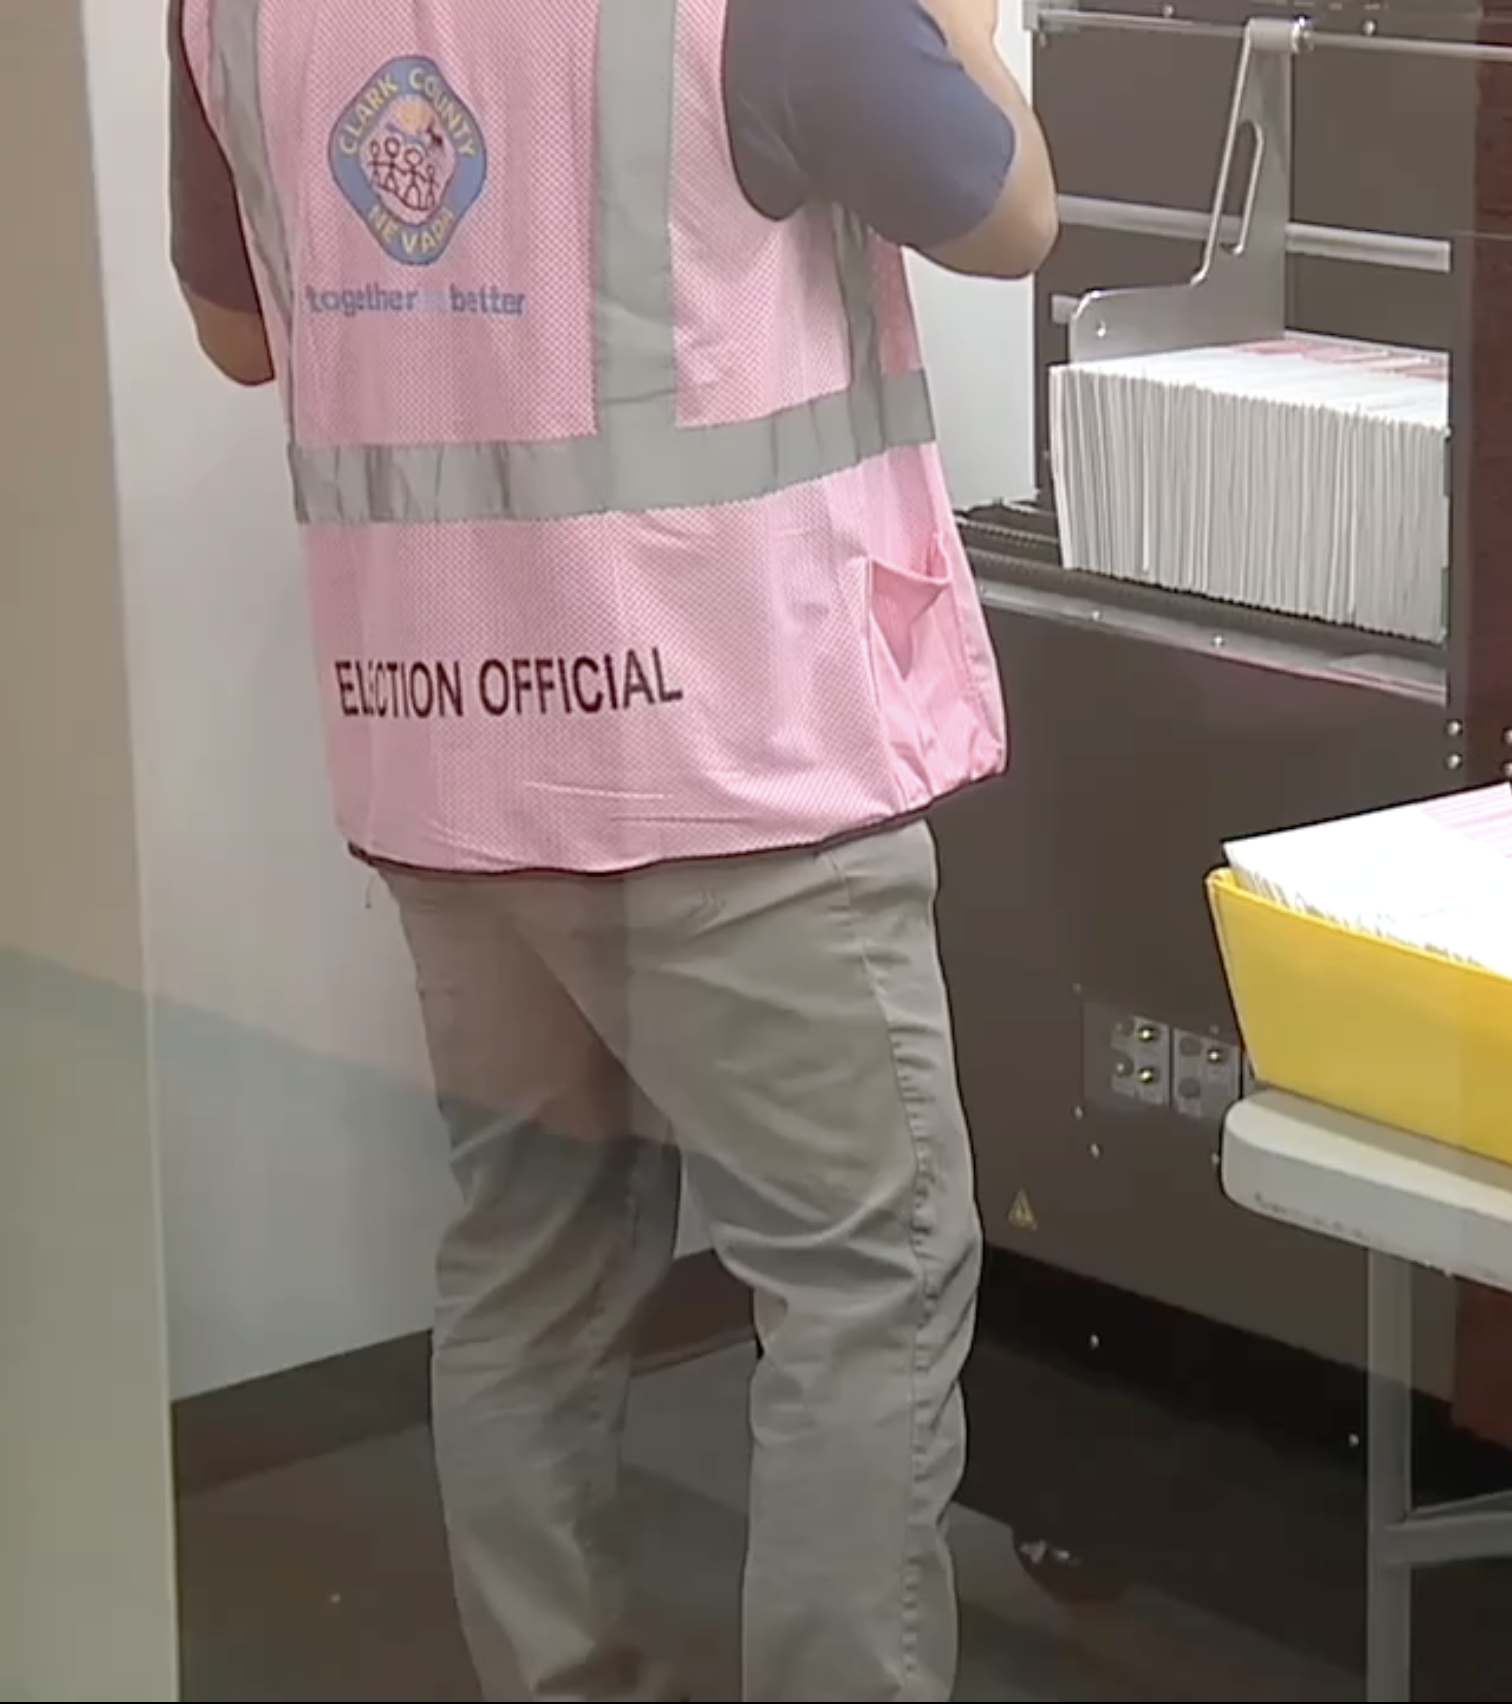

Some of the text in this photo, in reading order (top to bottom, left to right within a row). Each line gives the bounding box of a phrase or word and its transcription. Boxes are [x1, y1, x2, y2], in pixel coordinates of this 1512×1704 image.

[340, 67, 475, 157] CLARK COUNTY
[305, 282, 418, 317] together
[449, 283, 526, 315] better
[478, 647, 684, 716] OFFICIAL
